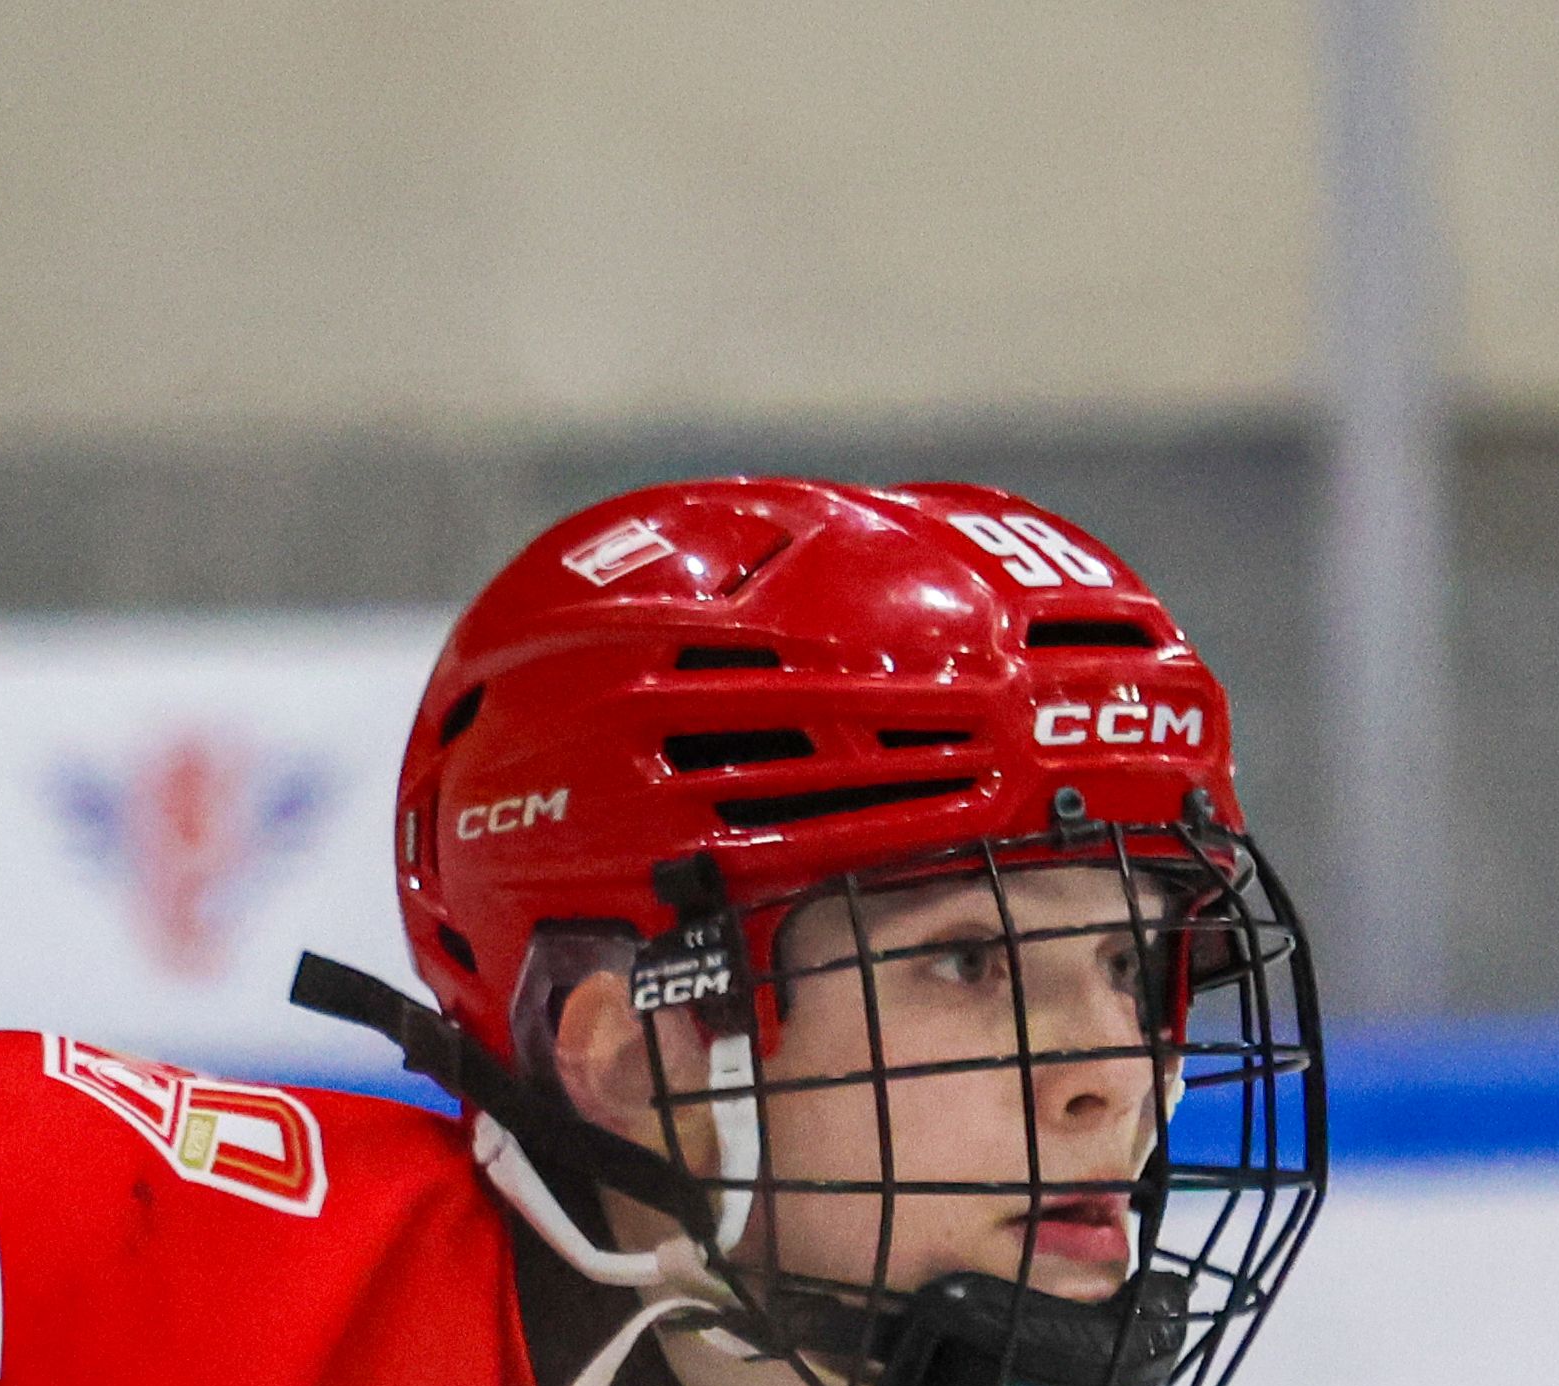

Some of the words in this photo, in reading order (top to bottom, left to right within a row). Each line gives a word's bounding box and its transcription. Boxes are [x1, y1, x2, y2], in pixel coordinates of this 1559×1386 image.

[946, 513, 1114, 588] 98
[1033, 702, 1203, 747] CCM
[456, 790, 569, 841] CCM
[634, 970, 731, 1011] CCM
